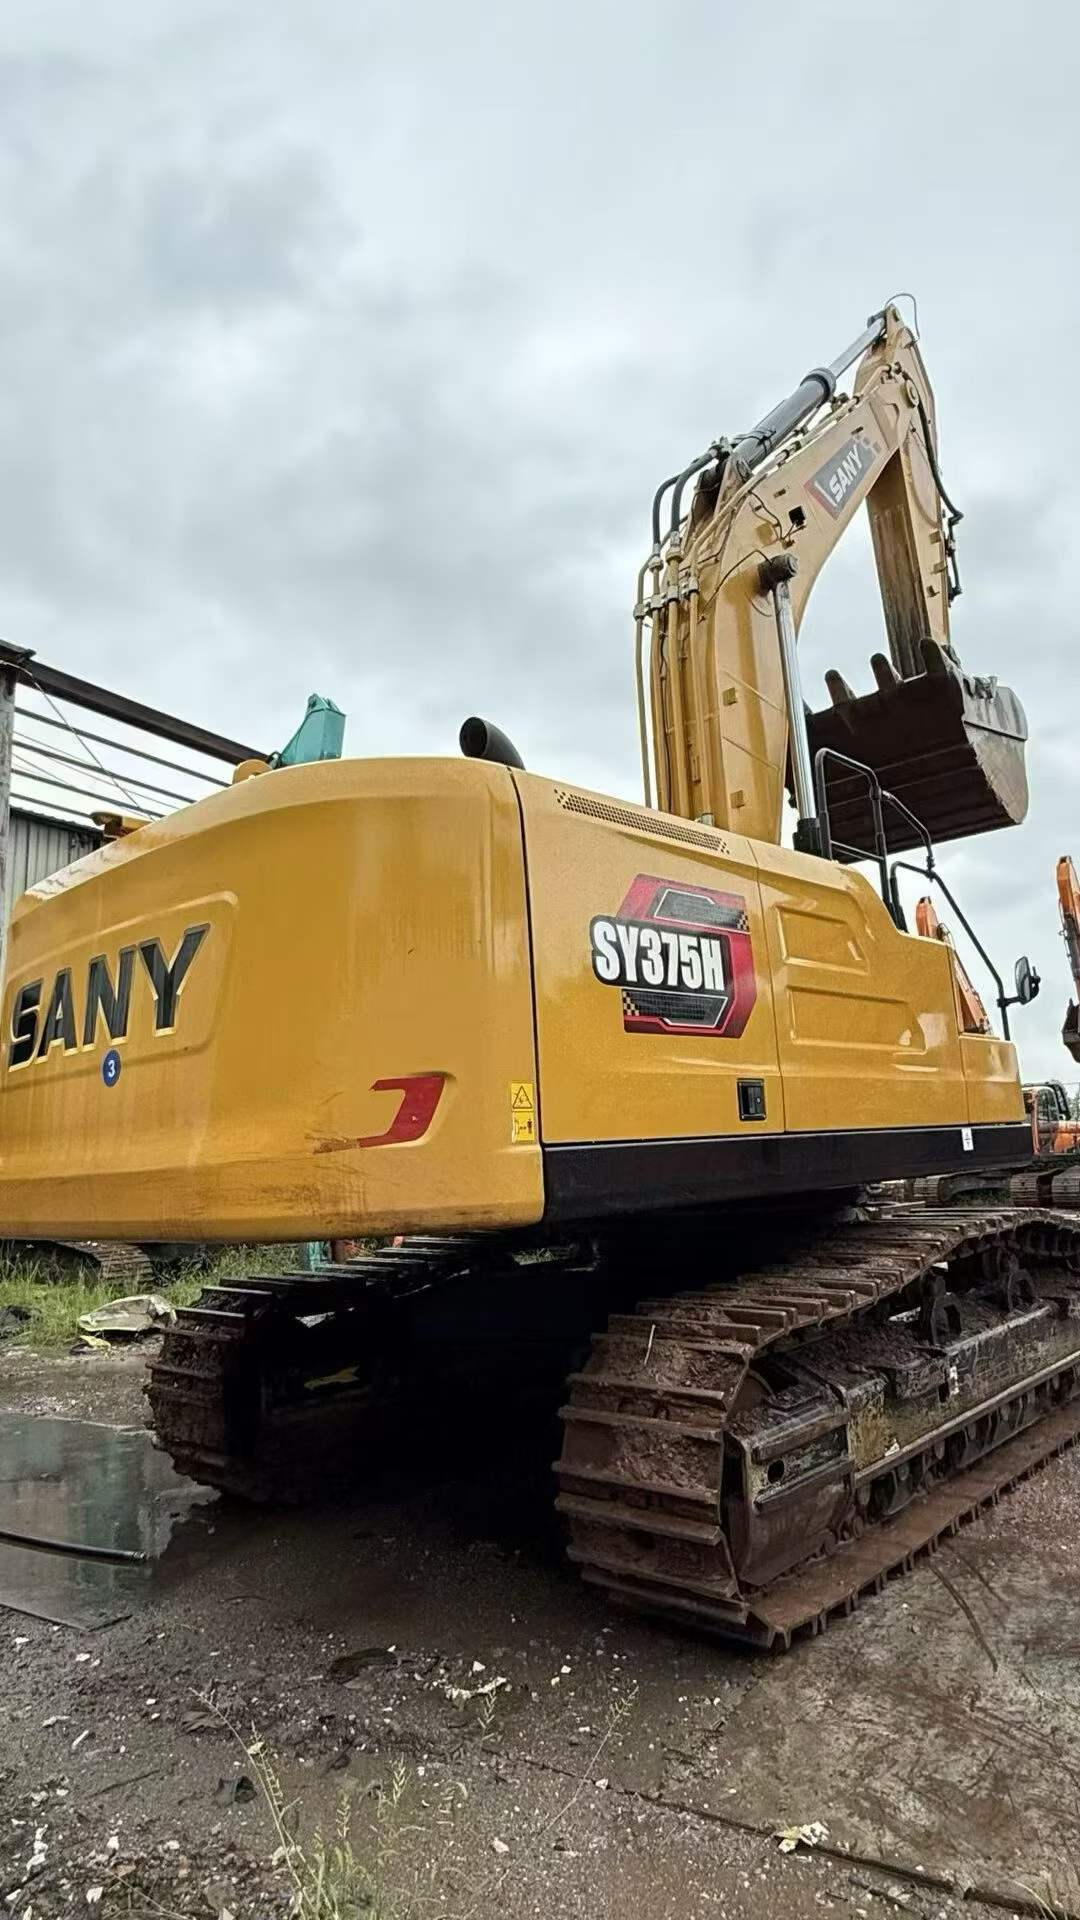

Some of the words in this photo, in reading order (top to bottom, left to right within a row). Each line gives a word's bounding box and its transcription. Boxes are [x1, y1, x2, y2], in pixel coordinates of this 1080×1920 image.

[829, 444, 862, 502] SANY
[593, 921, 725, 991] SY375H
[8, 922, 211, 1072] SANY
[108, 1059, 116, 1078] 3
